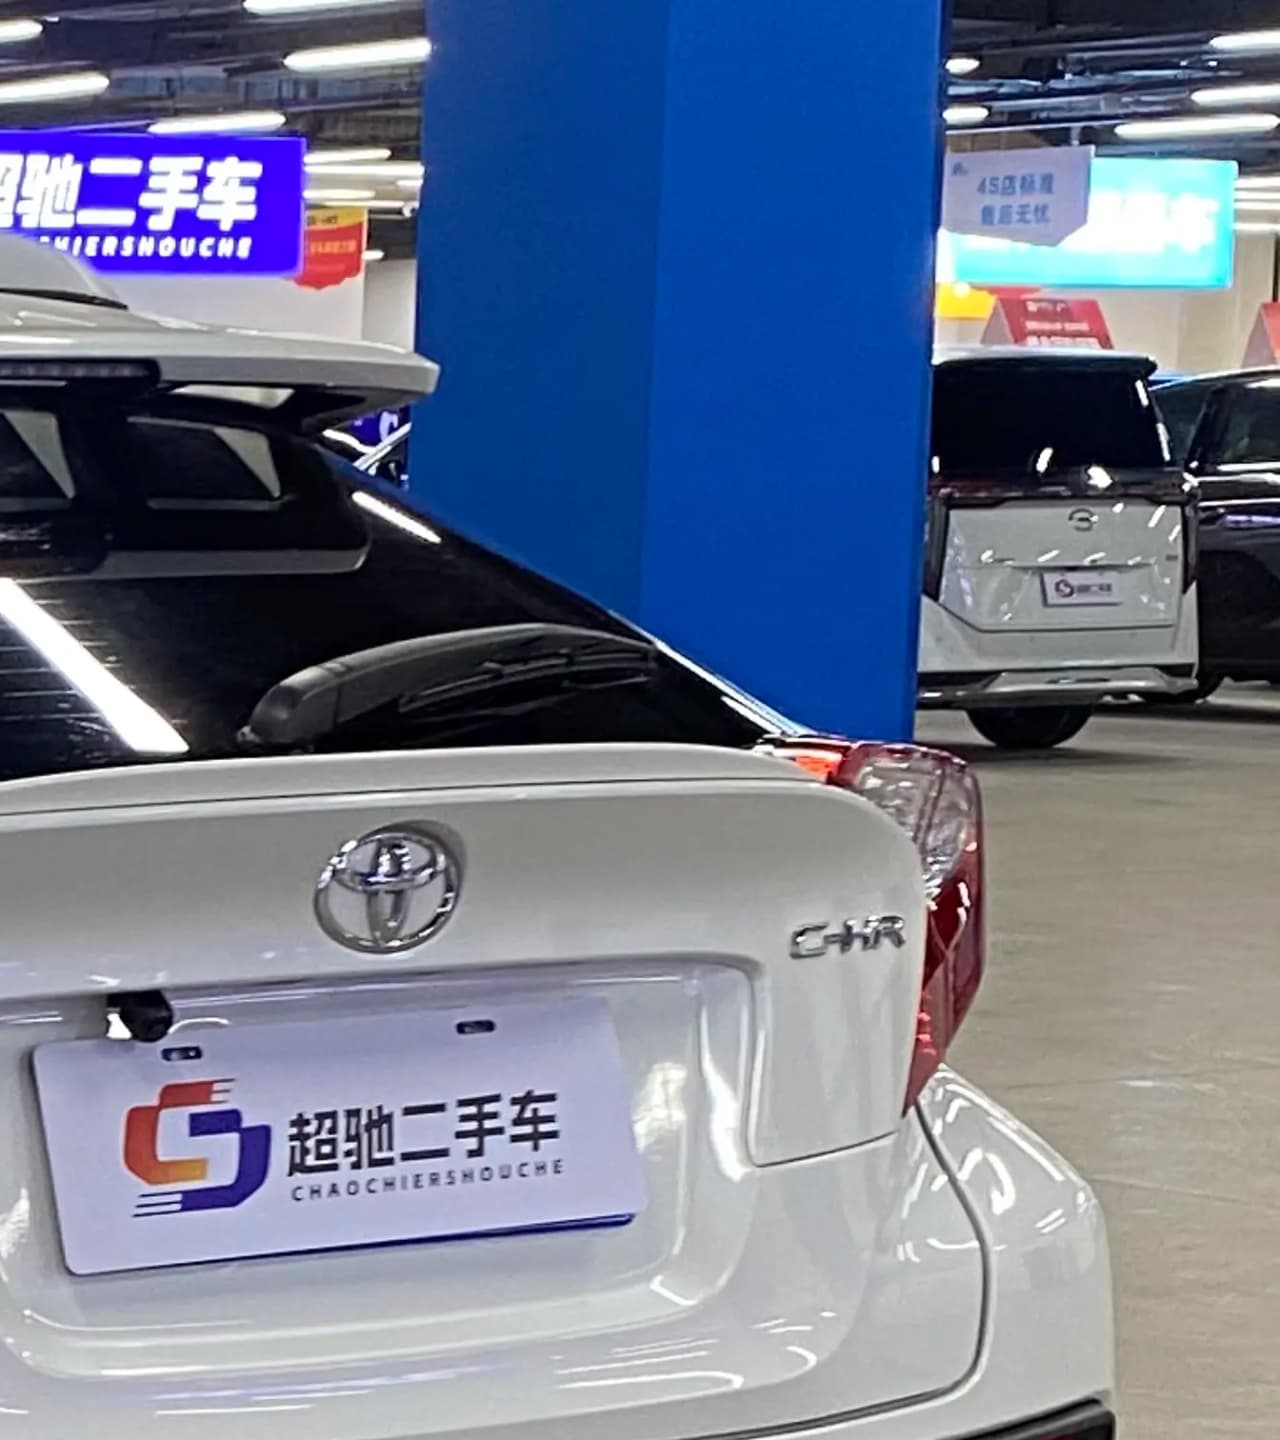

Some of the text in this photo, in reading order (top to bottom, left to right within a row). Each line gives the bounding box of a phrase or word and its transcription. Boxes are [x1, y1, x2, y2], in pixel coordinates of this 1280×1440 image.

[287, 1089, 561, 1178] 超驰二手车
[290, 1158, 564, 1202] CHAOCHIERSHOUCHE
